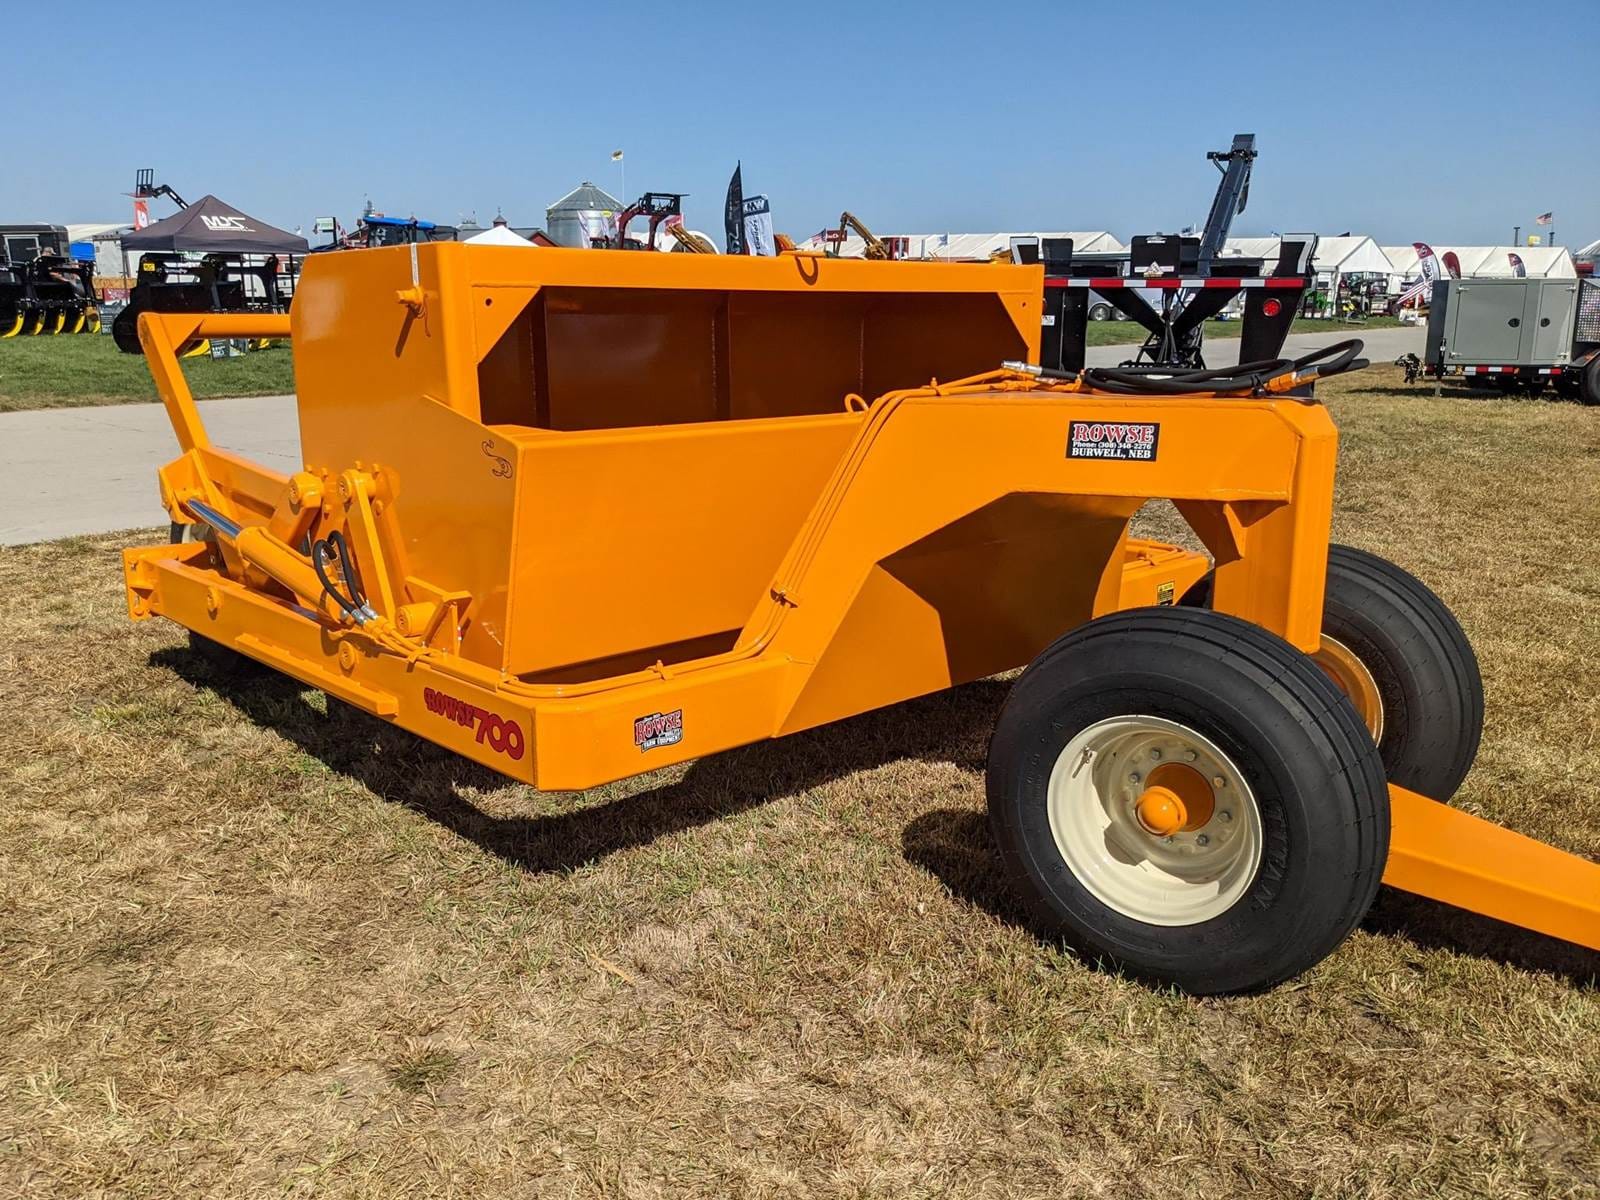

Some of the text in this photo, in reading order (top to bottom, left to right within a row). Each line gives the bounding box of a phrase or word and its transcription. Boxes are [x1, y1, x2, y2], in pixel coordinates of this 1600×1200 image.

[1072, 424, 1154, 443] ROWSE
[1072, 448, 1152, 459] BURWELL, NEB
[424, 687, 525, 760] ROWSE 700
[635, 711, 681, 744] ROWSE
